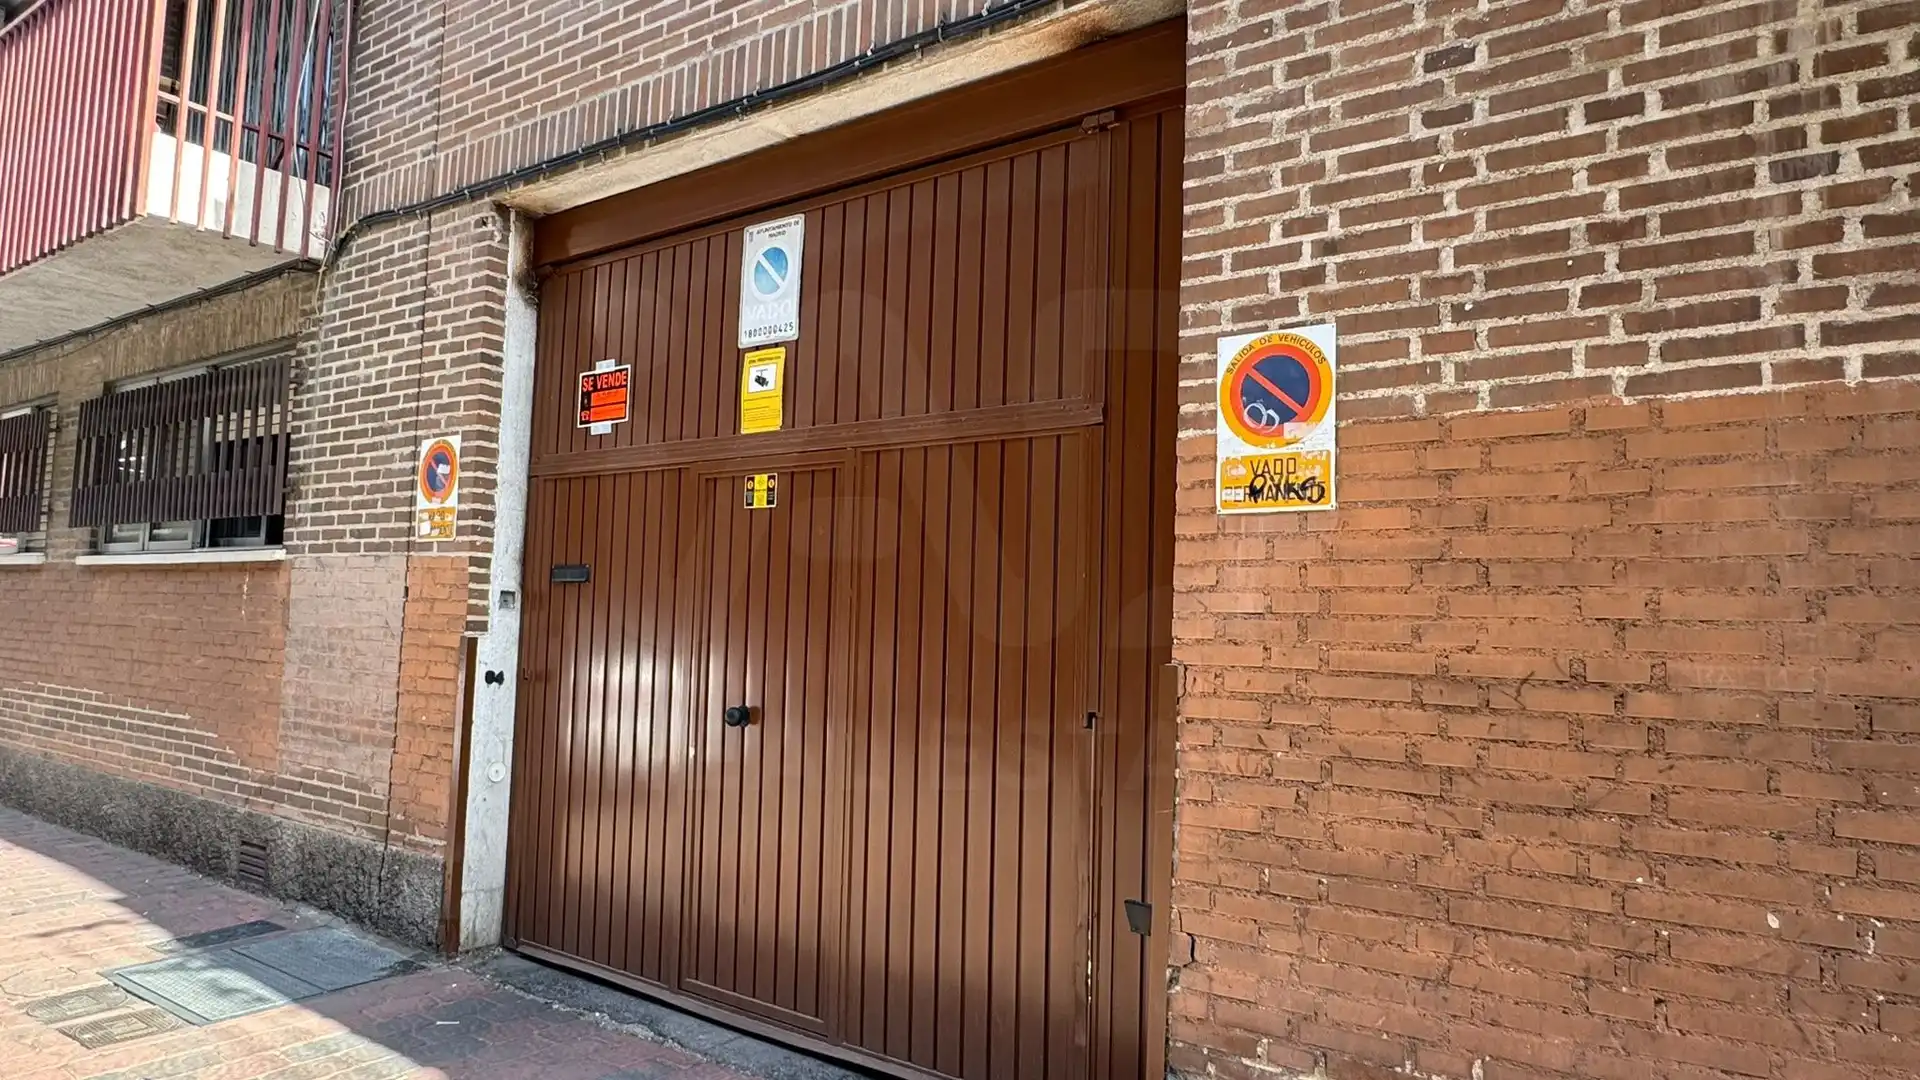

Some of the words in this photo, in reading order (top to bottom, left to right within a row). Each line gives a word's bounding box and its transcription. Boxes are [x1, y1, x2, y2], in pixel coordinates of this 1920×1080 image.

[1226, 344, 1255, 374] SALIDA
[1259, 336, 1273, 346] DE
[1278, 334, 1327, 365] VEHICULOS
[582, 377, 595, 392] SE
[596, 370, 628, 389] VENDE
[1250, 457, 1297, 475] VADO
